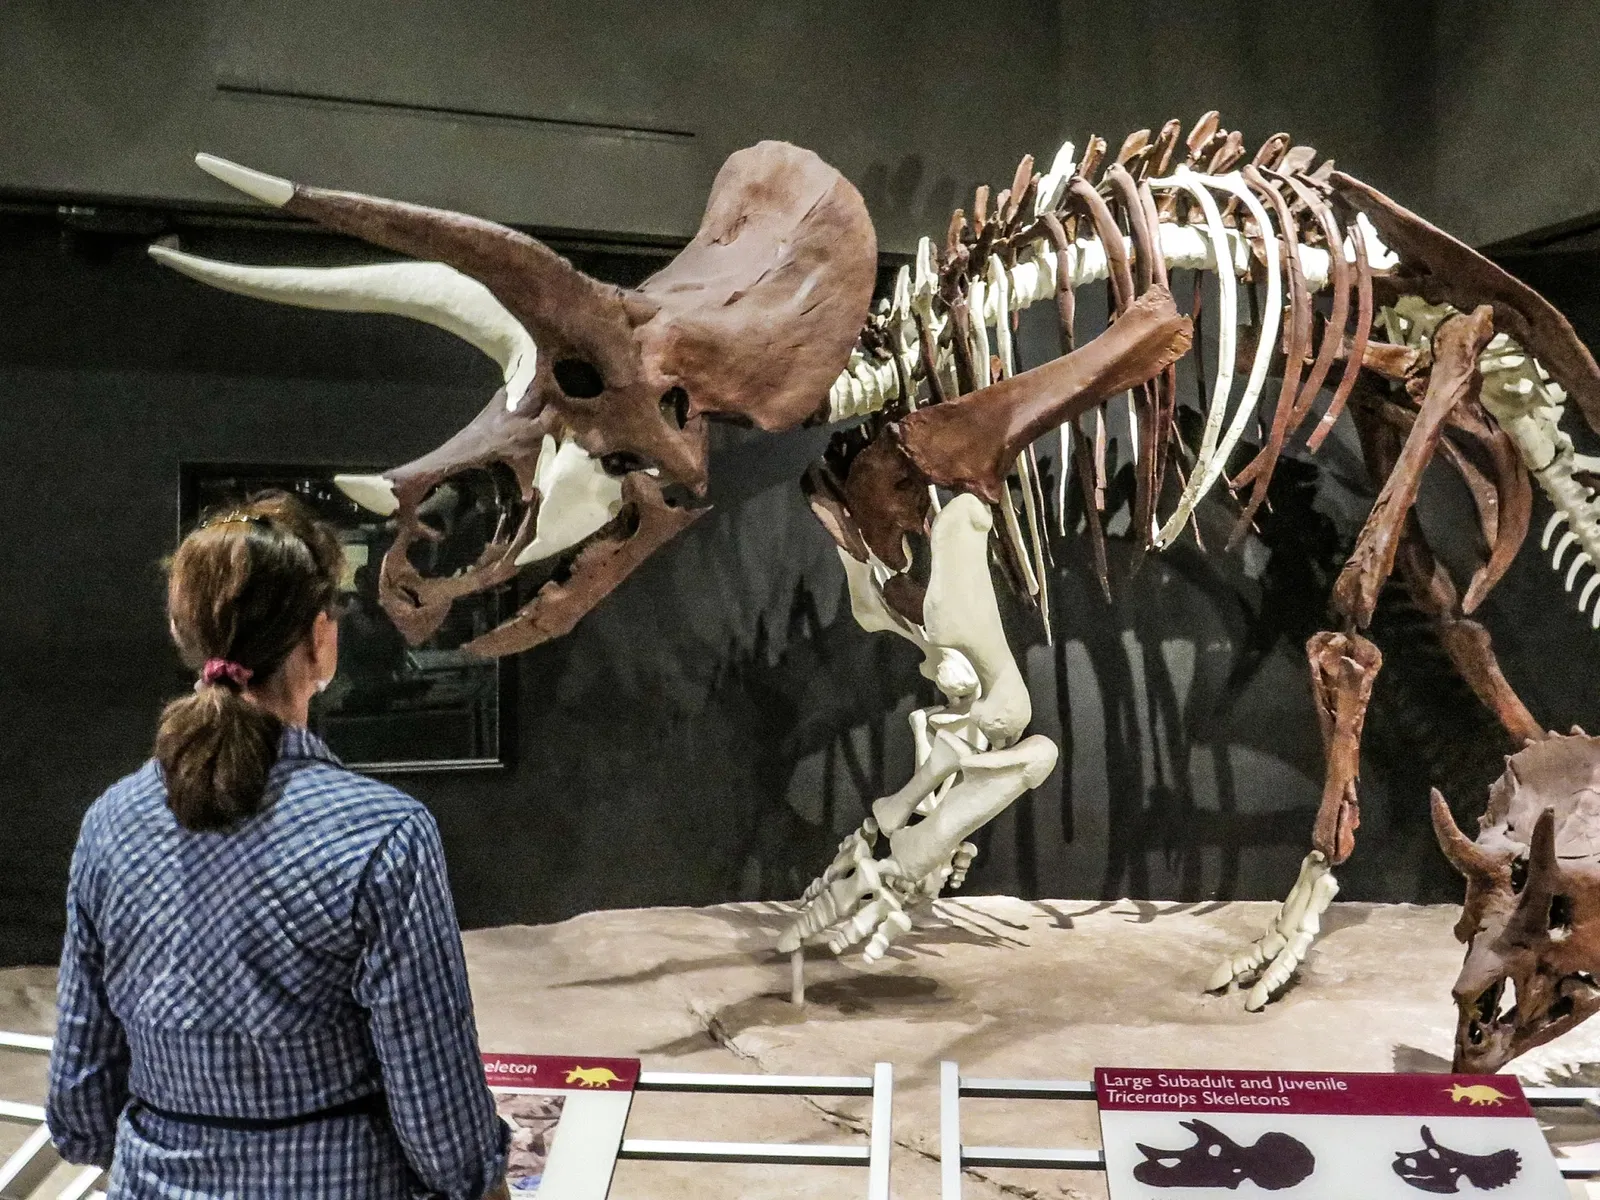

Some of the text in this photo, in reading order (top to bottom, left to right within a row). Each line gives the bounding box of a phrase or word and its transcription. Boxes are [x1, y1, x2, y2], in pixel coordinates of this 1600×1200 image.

[484, 1060, 538, 1075] eleton
[1103, 1073, 1348, 1093] Large Subadult and Juvenile
[1106, 1090, 1291, 1107] Triceratops Skeletons
